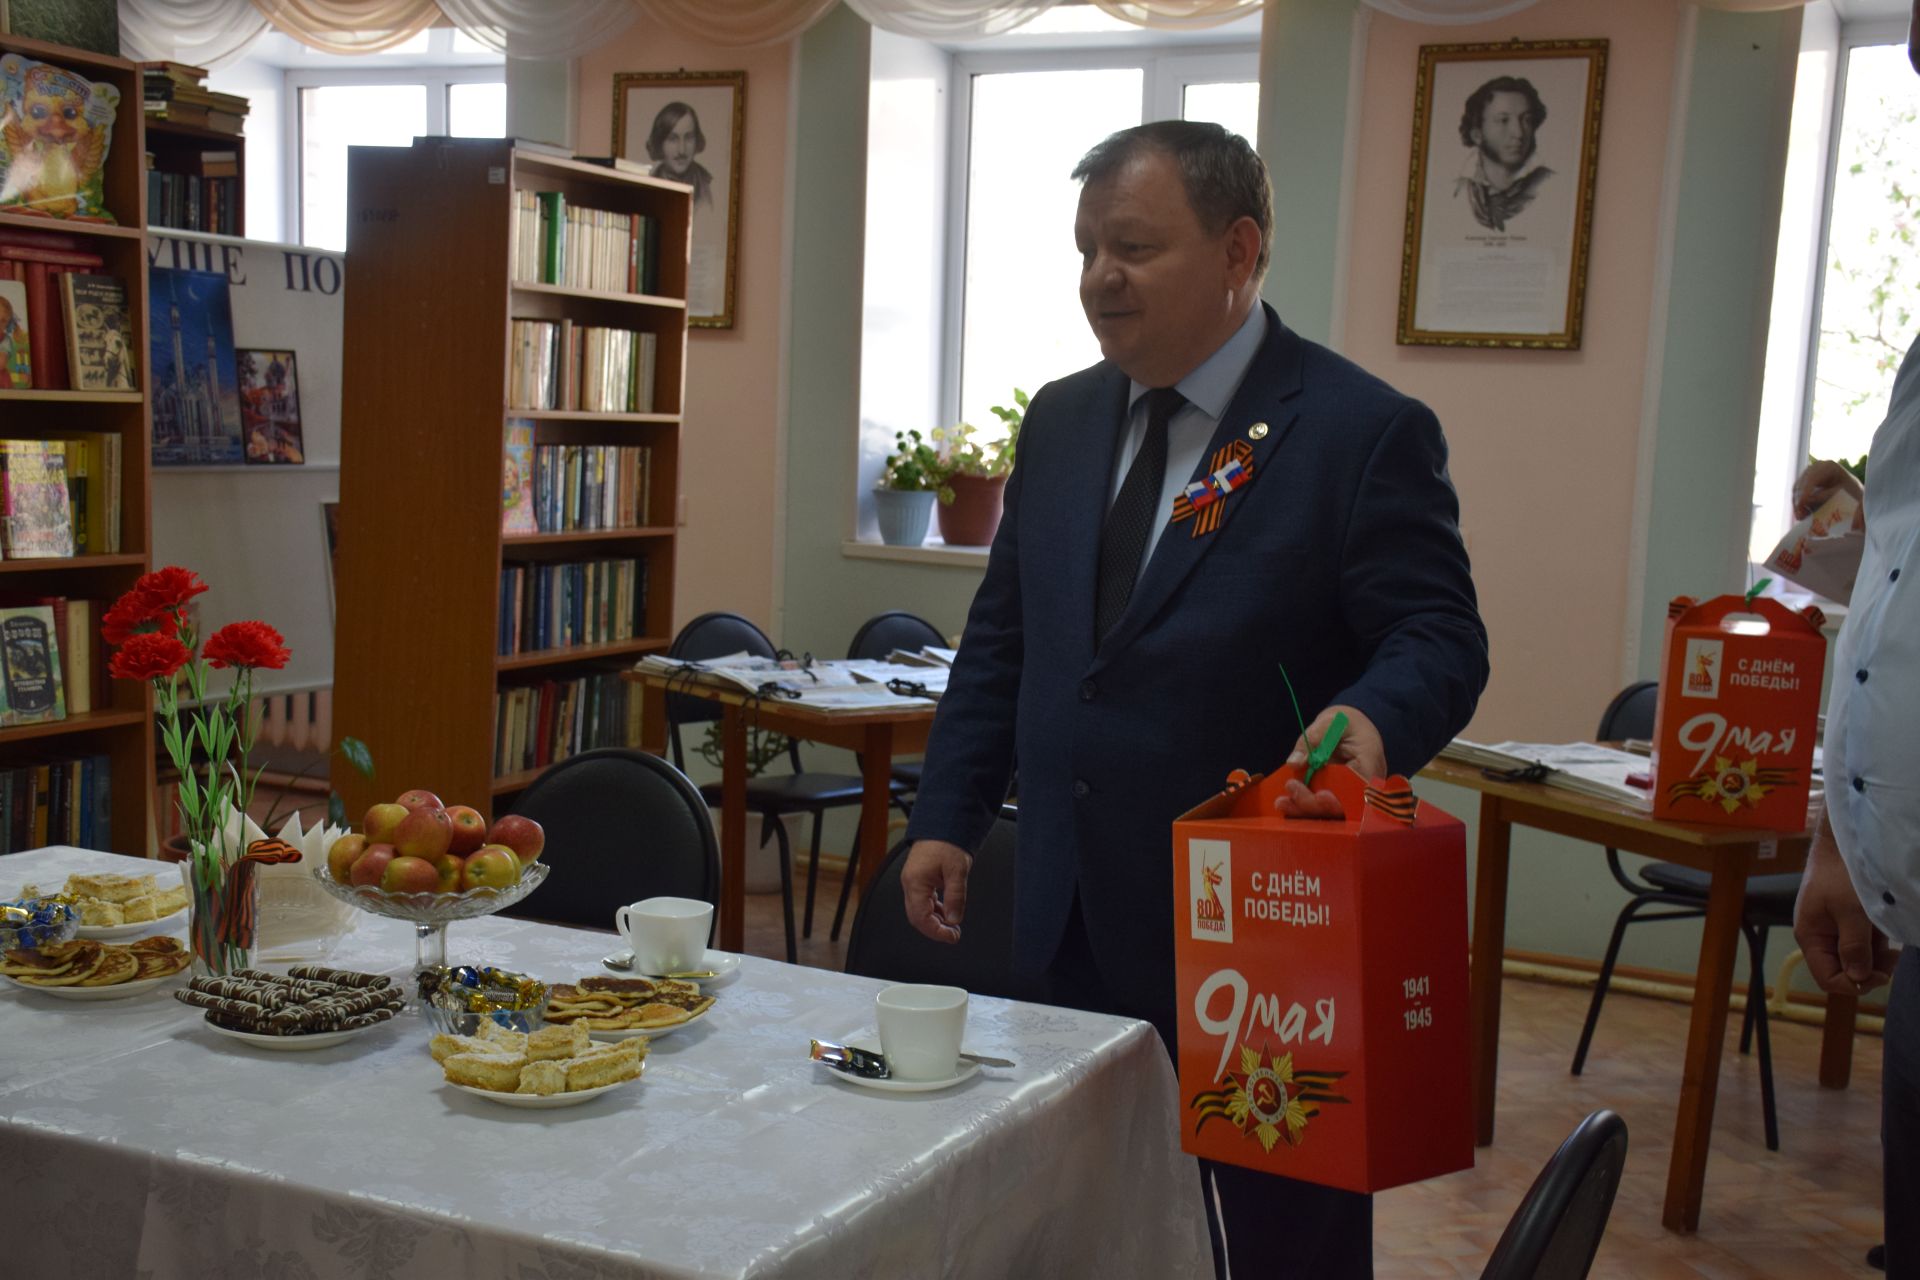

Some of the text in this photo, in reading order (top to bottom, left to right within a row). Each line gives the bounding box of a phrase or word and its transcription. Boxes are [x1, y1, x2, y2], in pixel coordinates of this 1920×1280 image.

[1738, 656, 1795, 674] С ДНЁМ
[1730, 674, 1799, 691] ПОБЕДЫ!
[1678, 712, 1796, 778] 9 мая
[1251, 869, 1320, 897] С ДНЁМ
[1197, 898, 1212, 917] 80
[1244, 898, 1330, 928] ПОБЕДЫ!
[1197, 919, 1226, 932] ПОБЕДА!
[1402, 976, 1430, 999] 1941
[1194, 968, 1336, 1084] 9 мая
[1403, 1007, 1432, 1031] 1945
